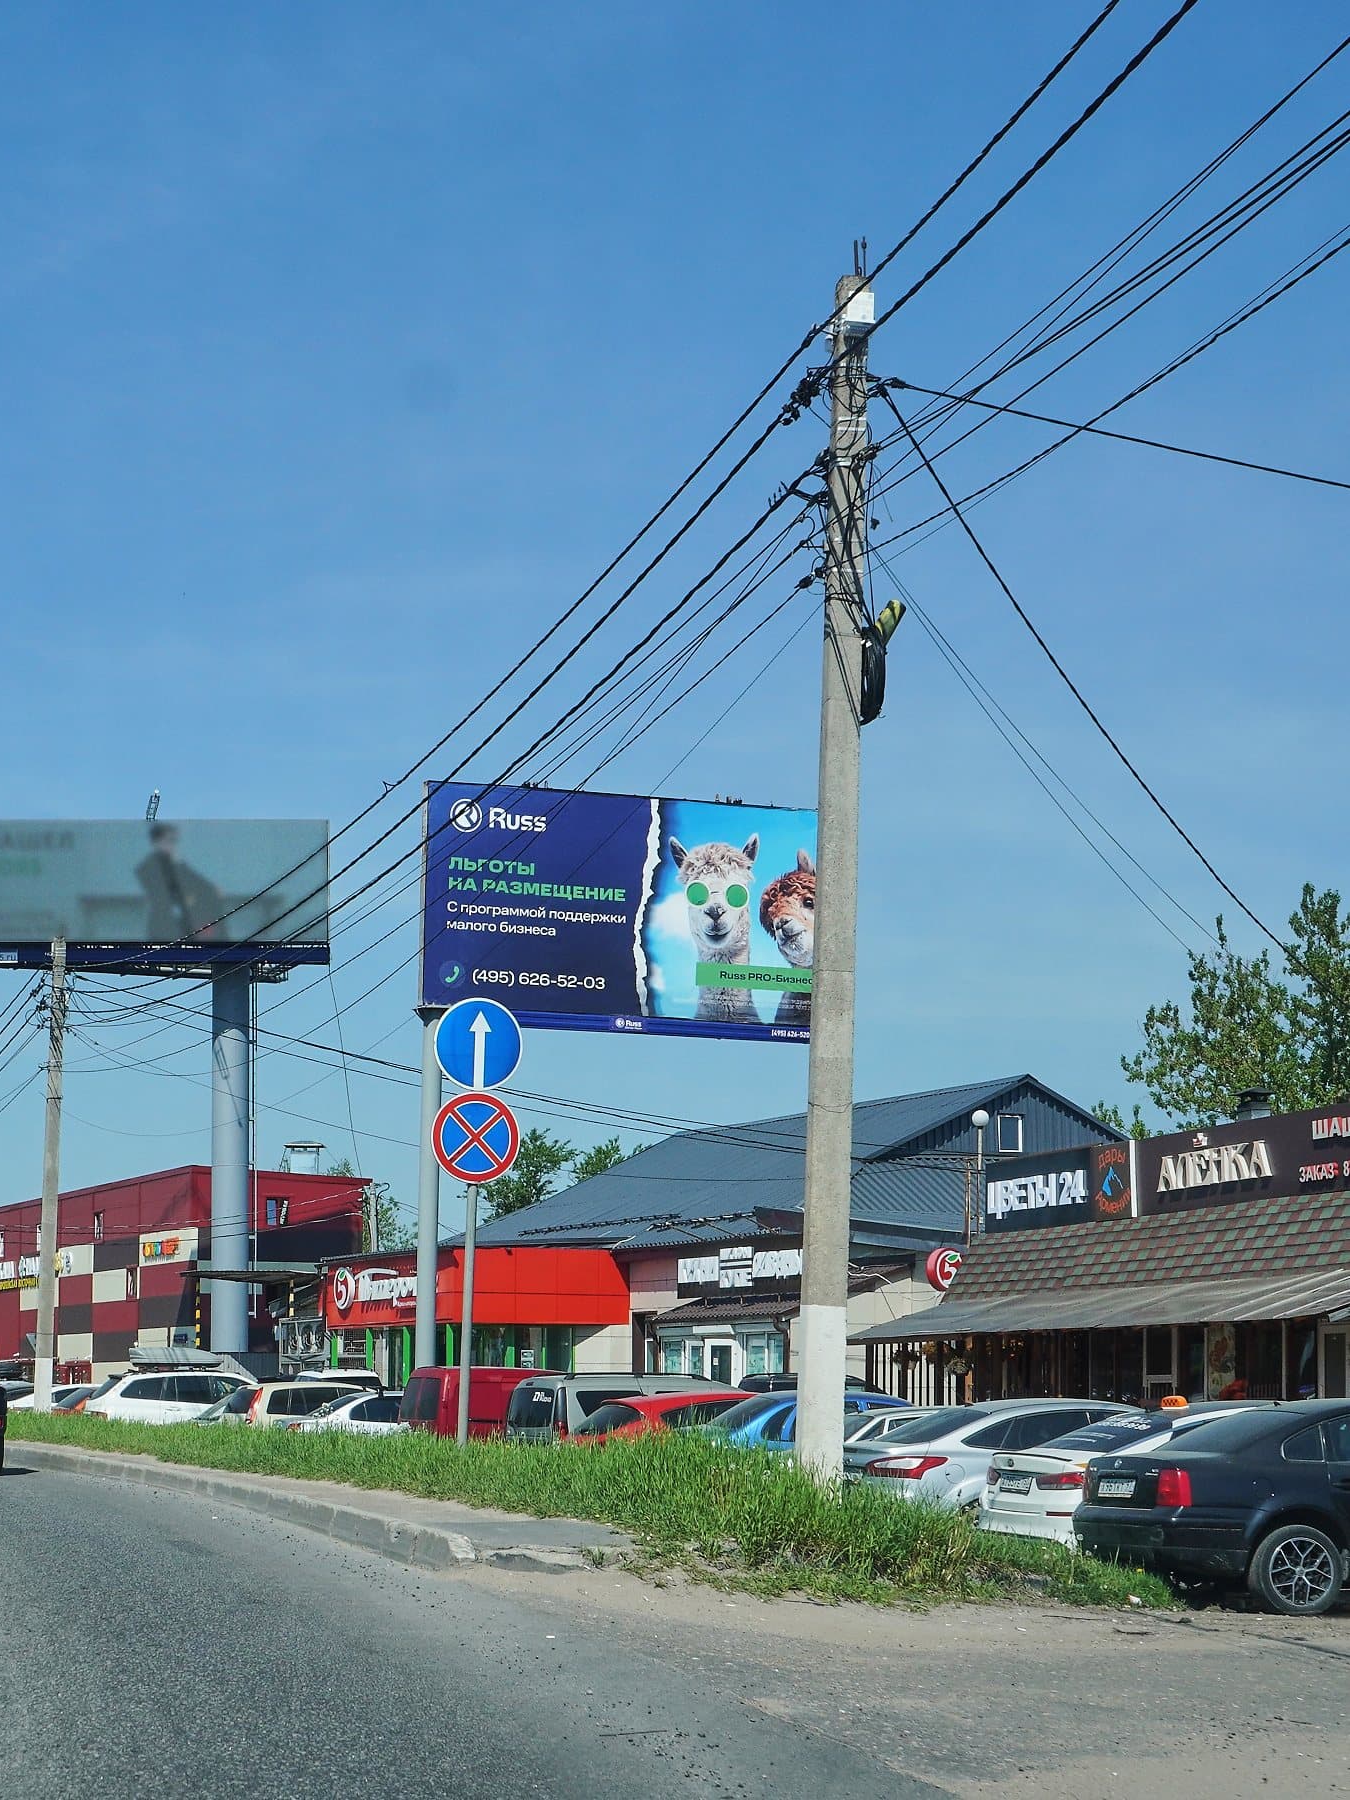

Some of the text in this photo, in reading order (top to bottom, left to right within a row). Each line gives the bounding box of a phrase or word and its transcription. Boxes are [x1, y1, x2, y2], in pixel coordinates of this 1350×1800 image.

[489, 807, 547, 832] Russ
[448, 856, 535, 876] ЛЬГОТЫ
[448, 876, 626, 902] НА РАЗМЕЩЕНИЕ
[446, 901, 627, 924] С программой поддержки
[446, 920, 557, 936] малого бизнеса
[472, 968, 606, 990] (495) 626-52-03
[720, 971, 746, 981] Russ
[987, 1169, 1088, 1220] ЦВЕТЫ 24
